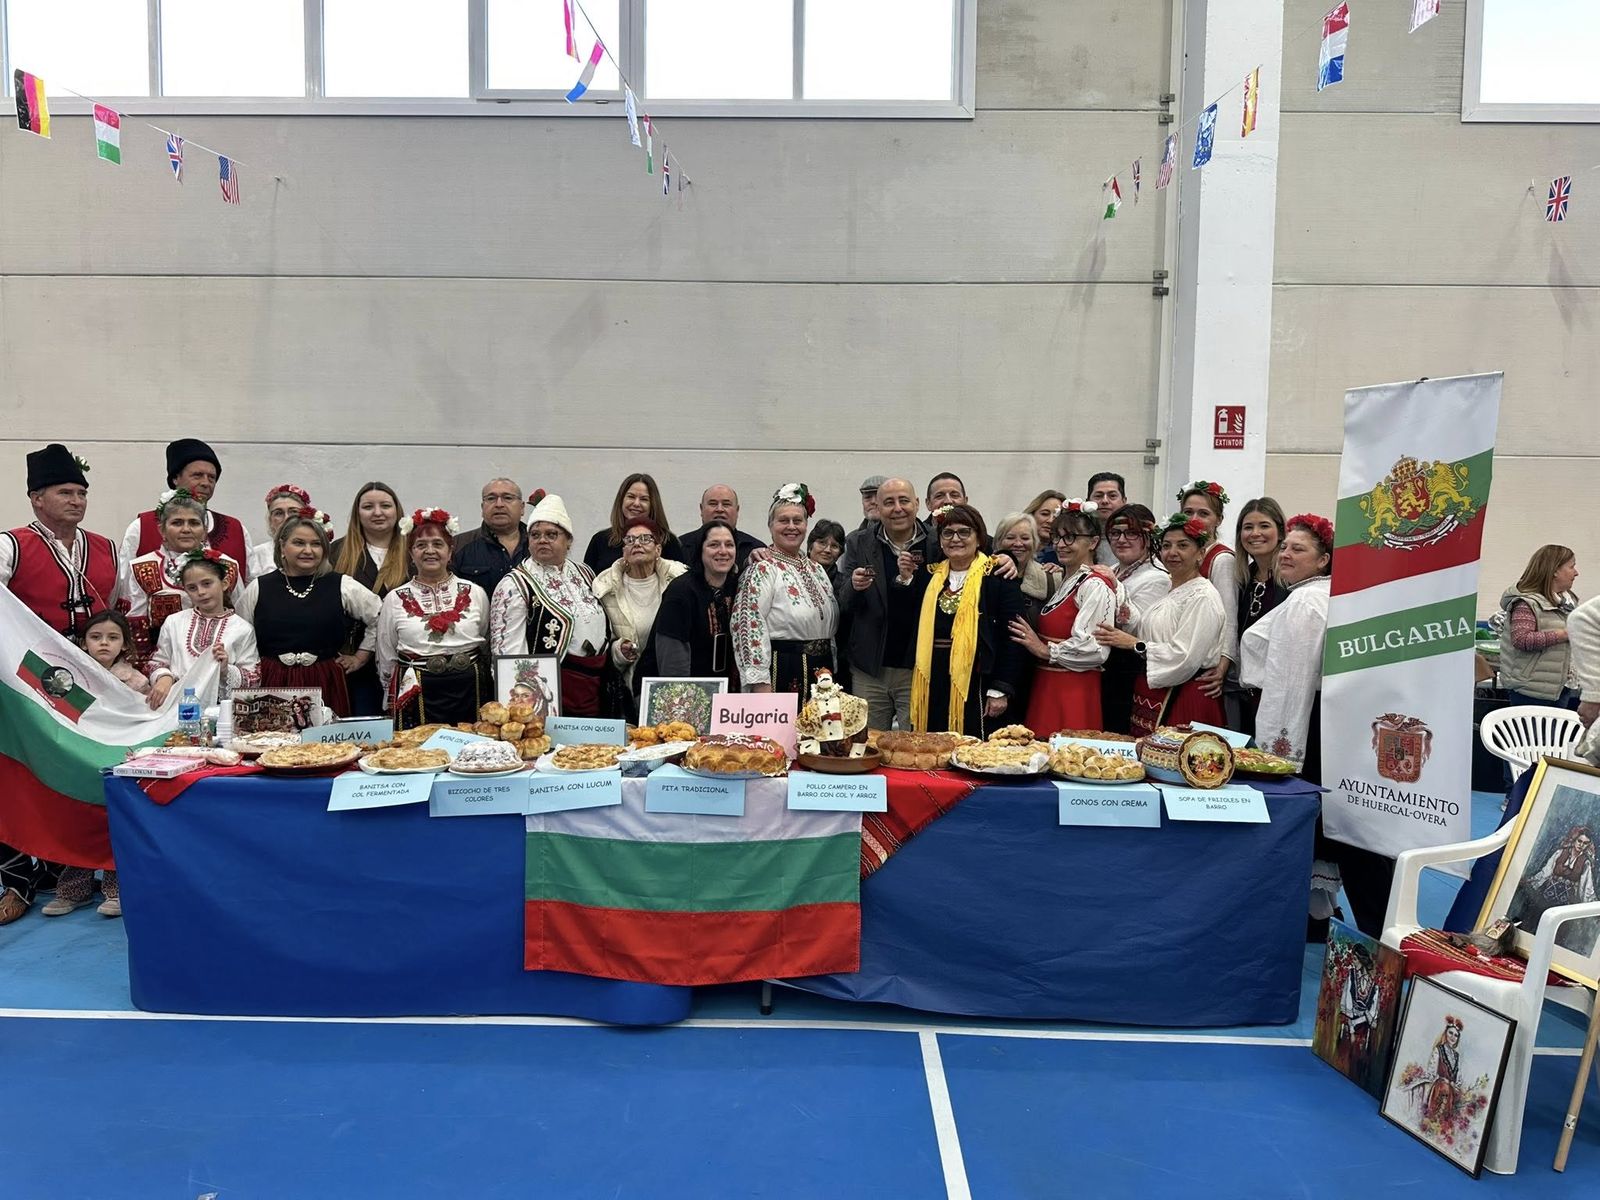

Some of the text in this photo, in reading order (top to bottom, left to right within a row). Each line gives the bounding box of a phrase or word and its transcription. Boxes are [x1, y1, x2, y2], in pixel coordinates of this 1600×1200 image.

[1215, 438, 1243, 446] EXTINTOR
[1338, 616, 1473, 658] BULGARIA
[719, 708, 789, 729] Bulgaria
[321, 731, 372, 743] BAKLAVA
[366, 789, 410, 797] FERMENTADA
[529, 785, 565, 795] BANITSA
[586, 780, 613, 789] LUCUM
[681, 785, 729, 794] TRADICIONAL
[1070, 798, 1099, 806] CONOS
[1338, 778, 1459, 816] AYUNTAMIENTO
[1347, 795, 1447, 827] DE HUERCAL-OVERA
